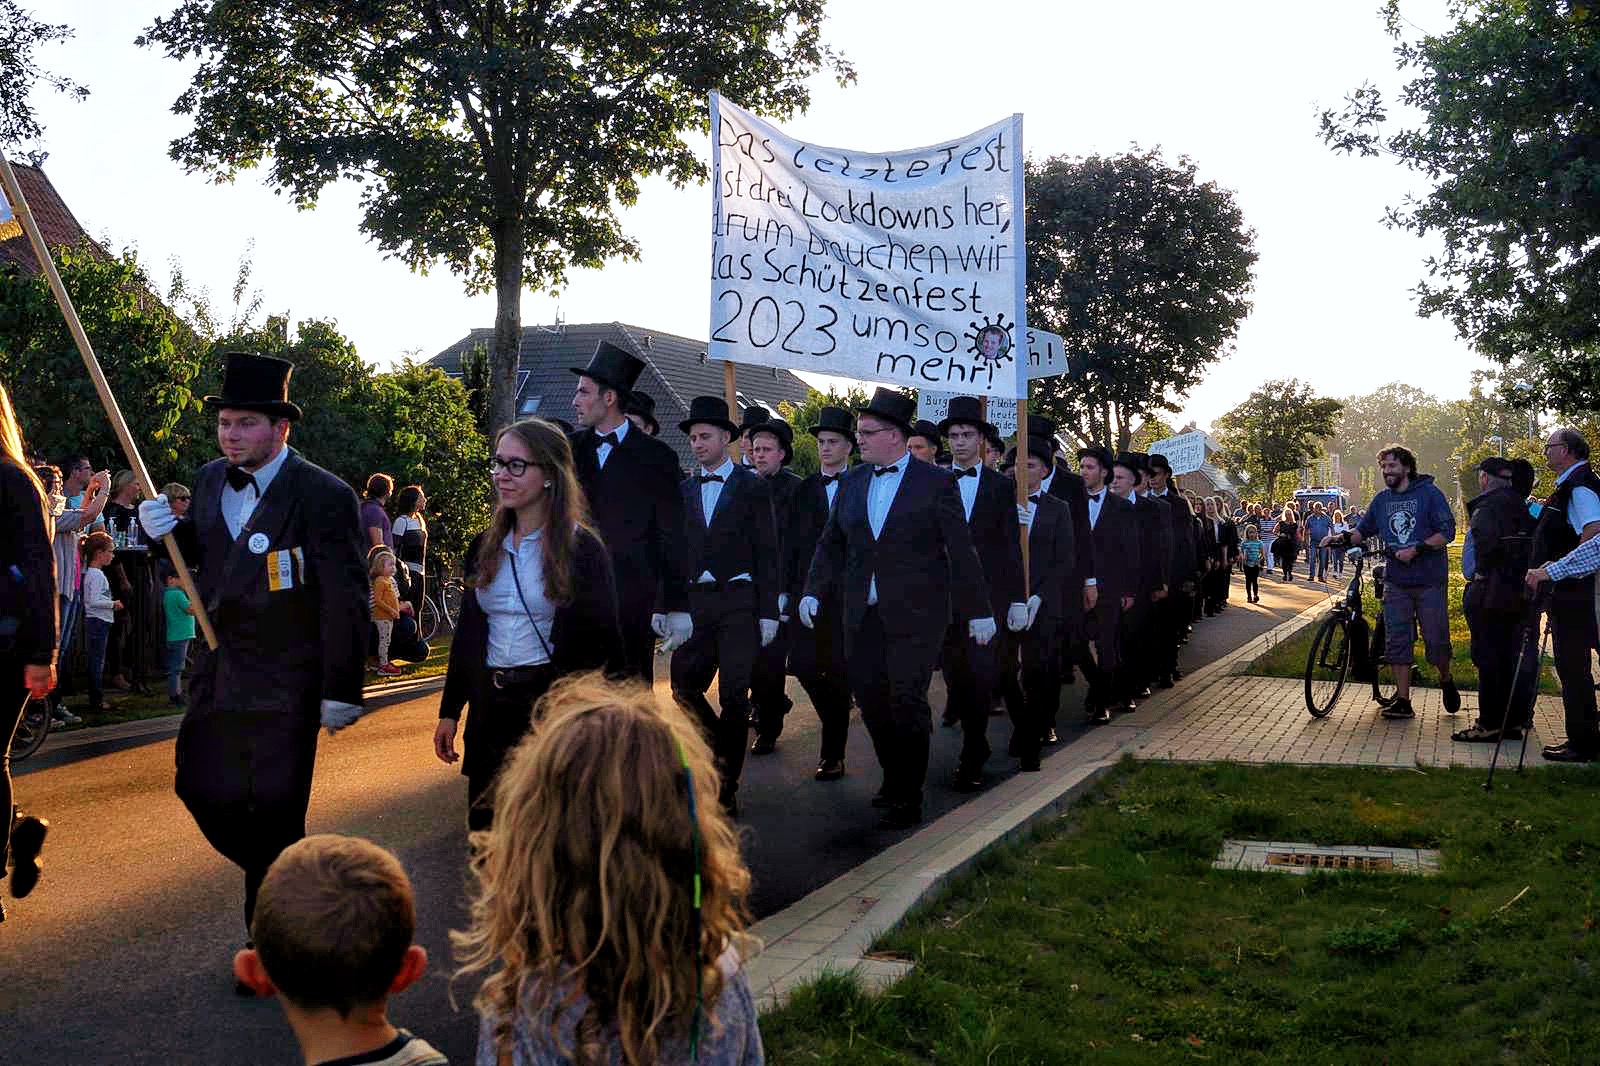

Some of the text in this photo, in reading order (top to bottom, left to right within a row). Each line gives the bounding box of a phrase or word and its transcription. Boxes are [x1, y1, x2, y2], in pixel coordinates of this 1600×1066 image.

[719, 115, 775, 163] Das
[749, 170, 792, 209] drei
[802, 180, 954, 230] Lockdowns
[964, 185, 1011, 233] her,
[763, 247, 983, 313] Schützenfest
[956, 235, 1008, 273] wir
[711, 289, 958, 357] 2023 umso
[876, 351, 994, 390] mehr!
